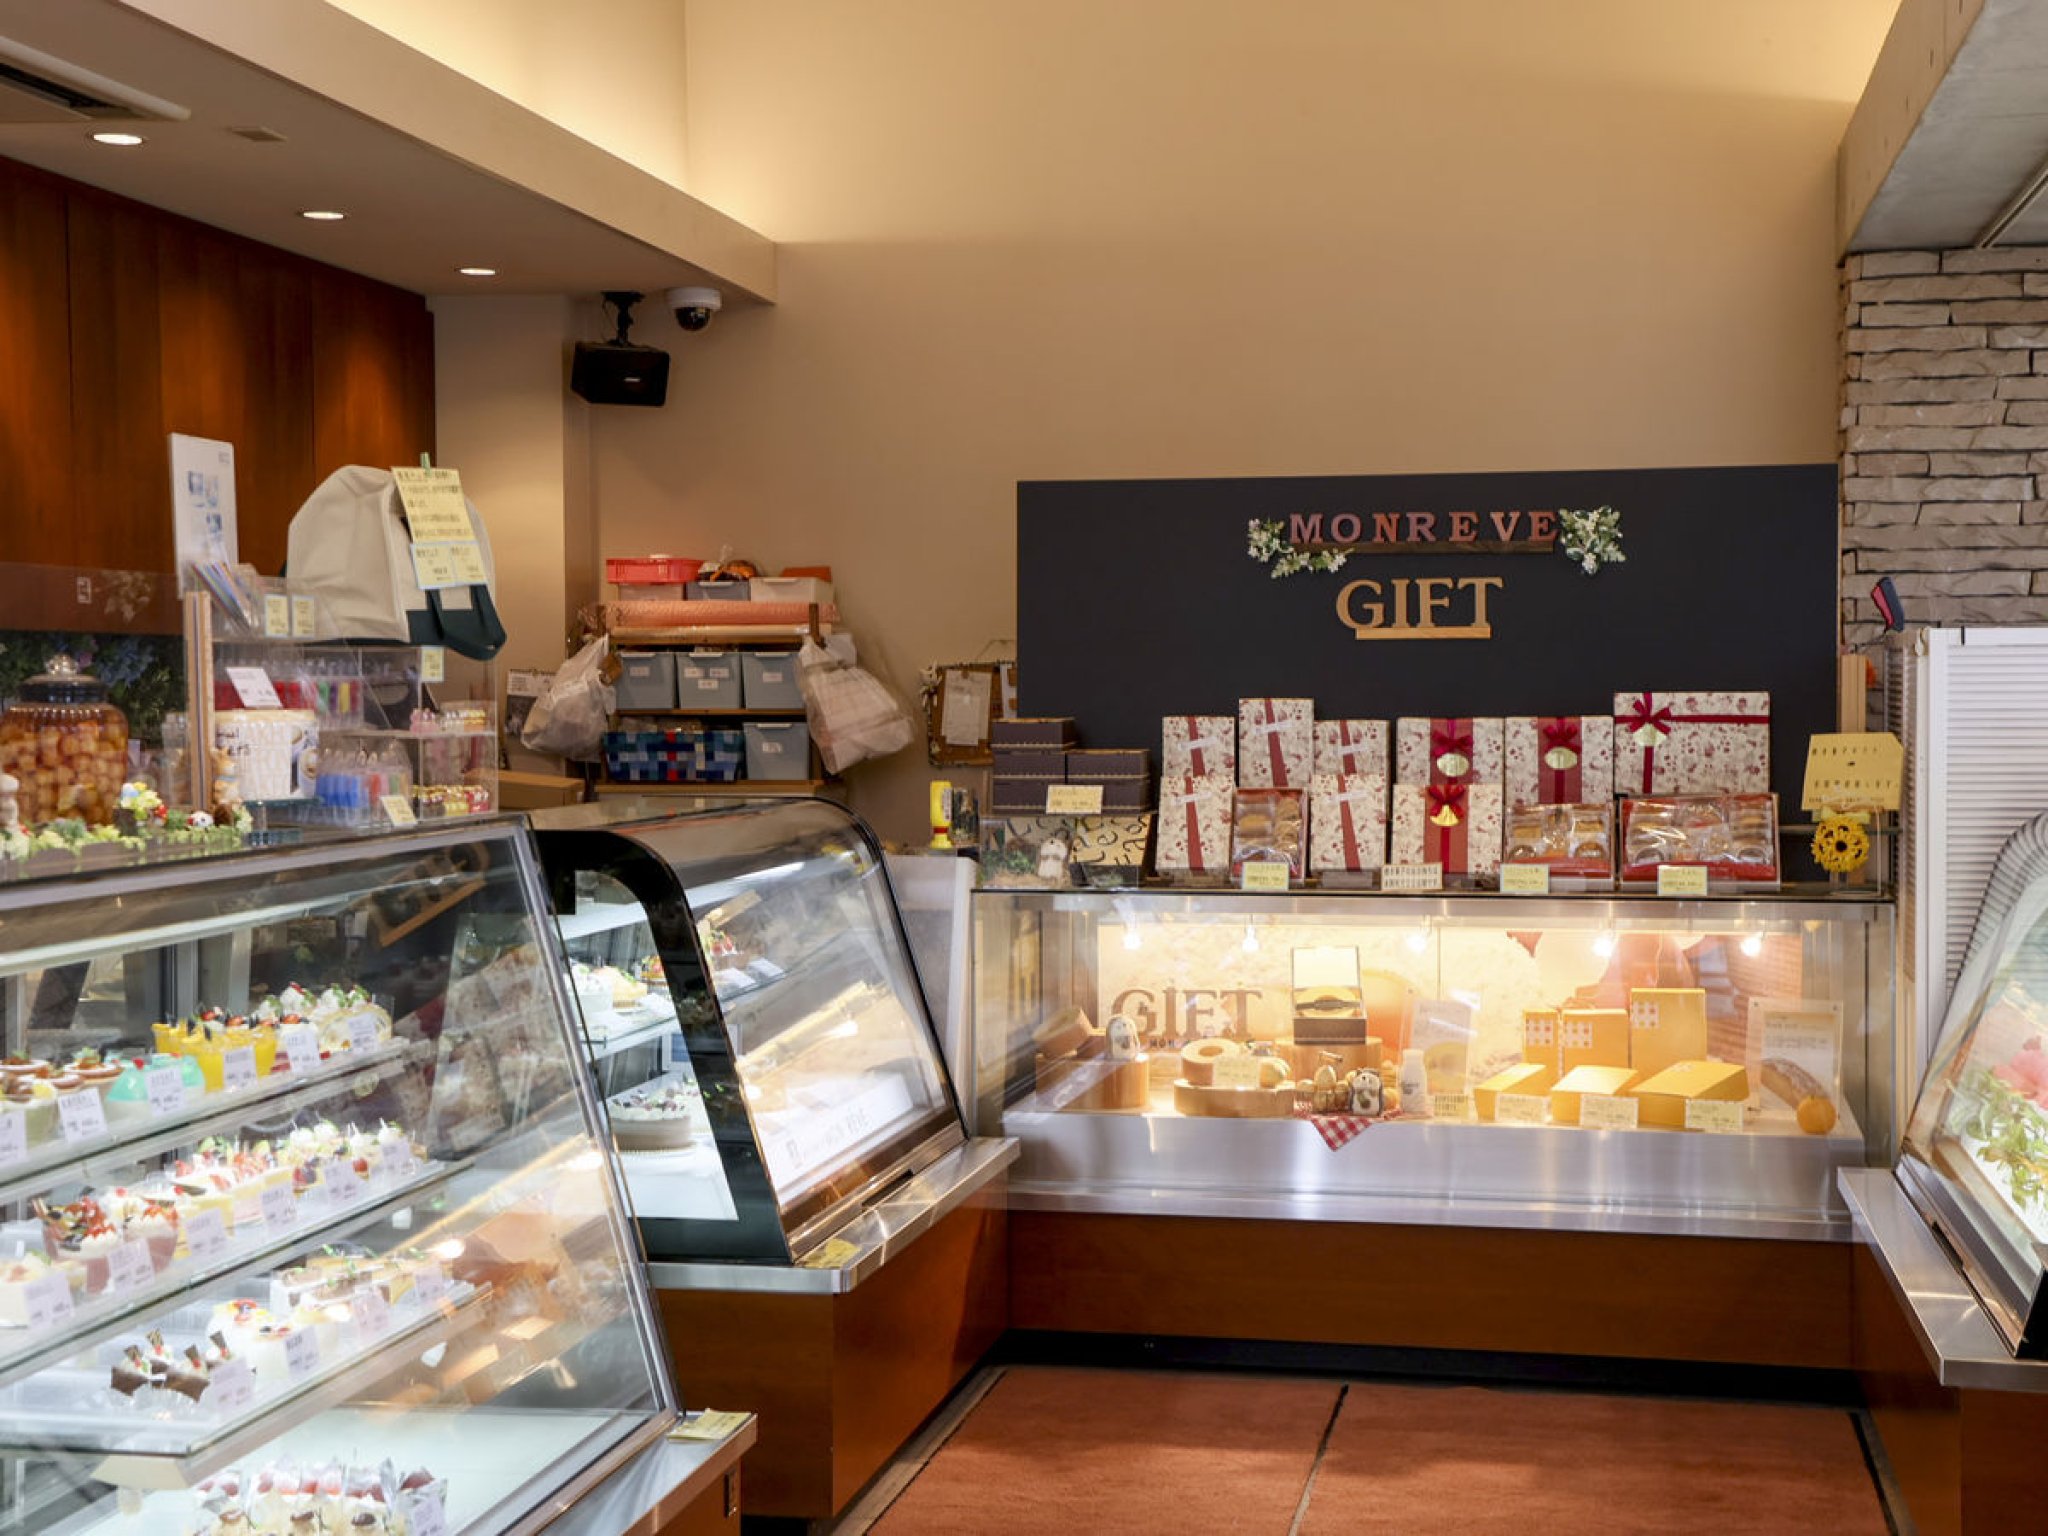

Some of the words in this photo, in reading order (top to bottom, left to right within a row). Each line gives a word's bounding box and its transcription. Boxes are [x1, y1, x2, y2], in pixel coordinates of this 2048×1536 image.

[1288, 511, 1559, 543] MONREVE
[1335, 577, 1503, 629] GIFT
[1112, 988, 1263, 1038] GIFT
